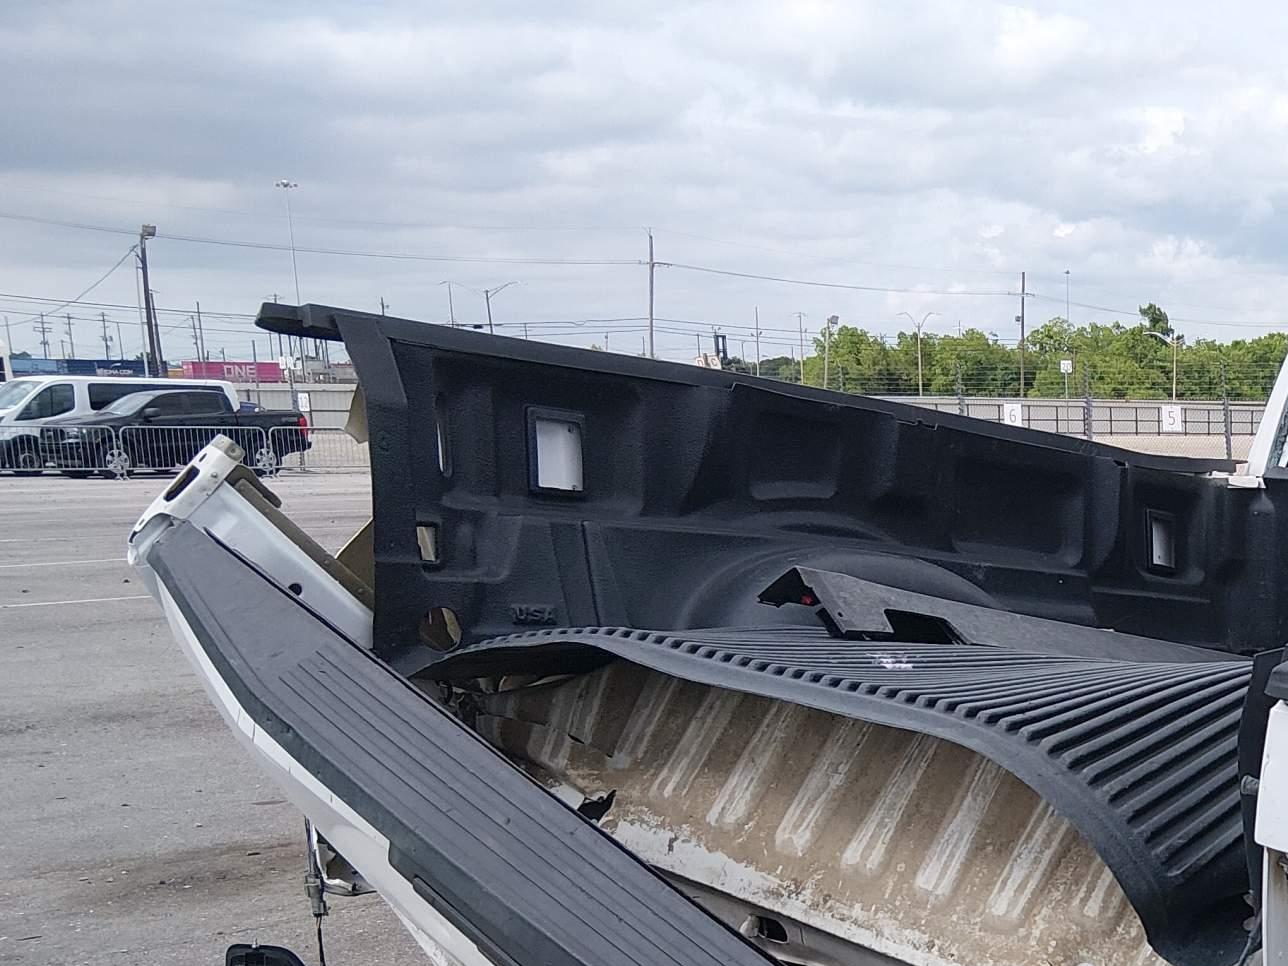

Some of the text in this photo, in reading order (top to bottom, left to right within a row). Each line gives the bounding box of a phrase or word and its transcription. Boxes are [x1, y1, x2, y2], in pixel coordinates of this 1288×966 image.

[223, 364, 257, 378] ONE
[1009, 408, 1017, 424] 6
[1167, 410, 1176, 426] 5
